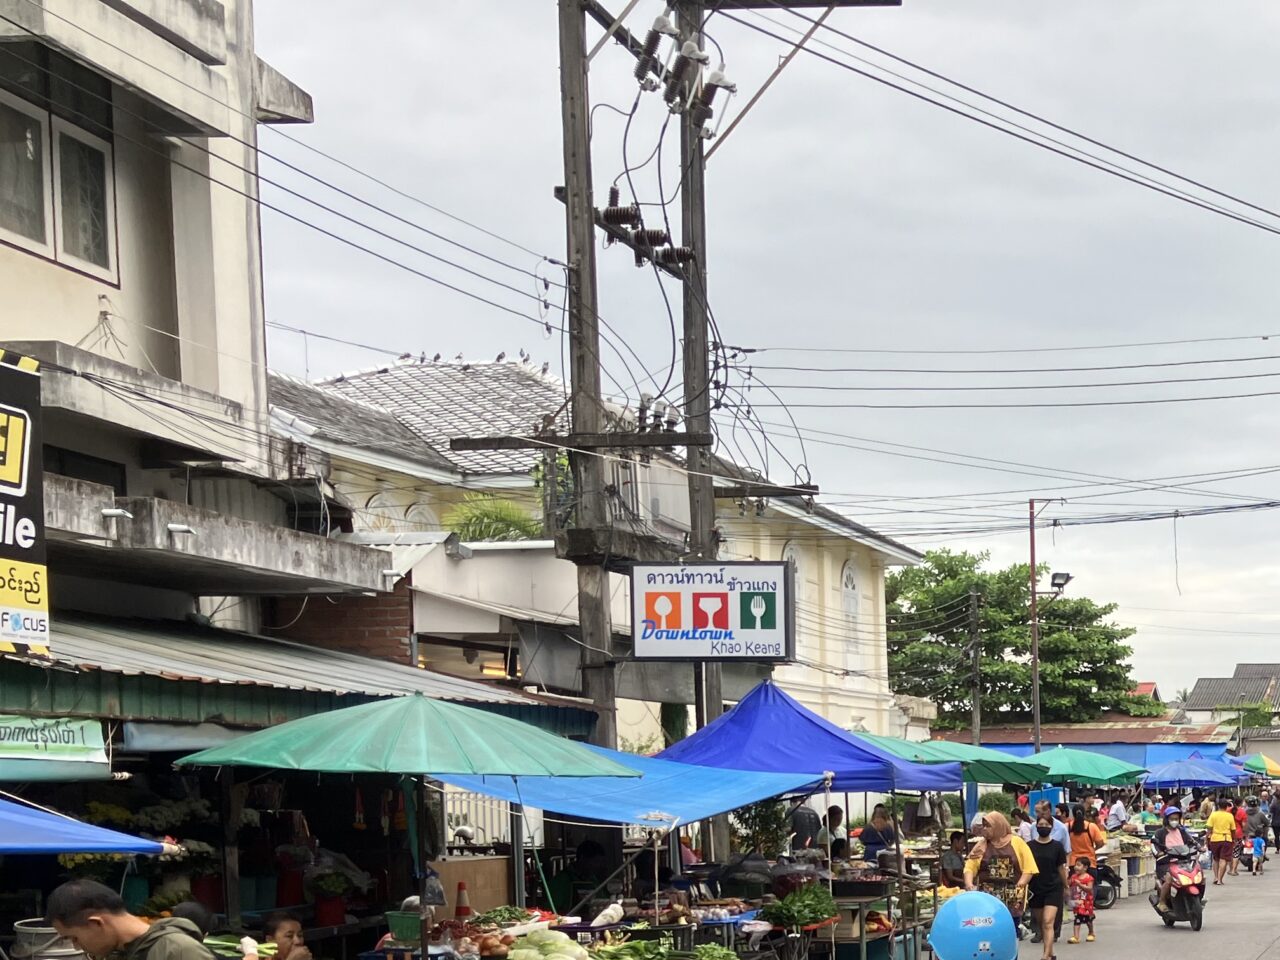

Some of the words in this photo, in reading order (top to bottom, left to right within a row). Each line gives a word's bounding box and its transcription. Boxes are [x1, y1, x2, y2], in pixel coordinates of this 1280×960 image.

[647, 567, 725, 584] ดาวน์ทาวน์
[727, 577, 777, 592] ข้าวแกง
[641, 620, 734, 640] Downtown
[711, 641, 742, 655] Khao
[745, 641, 780, 656] Keang
